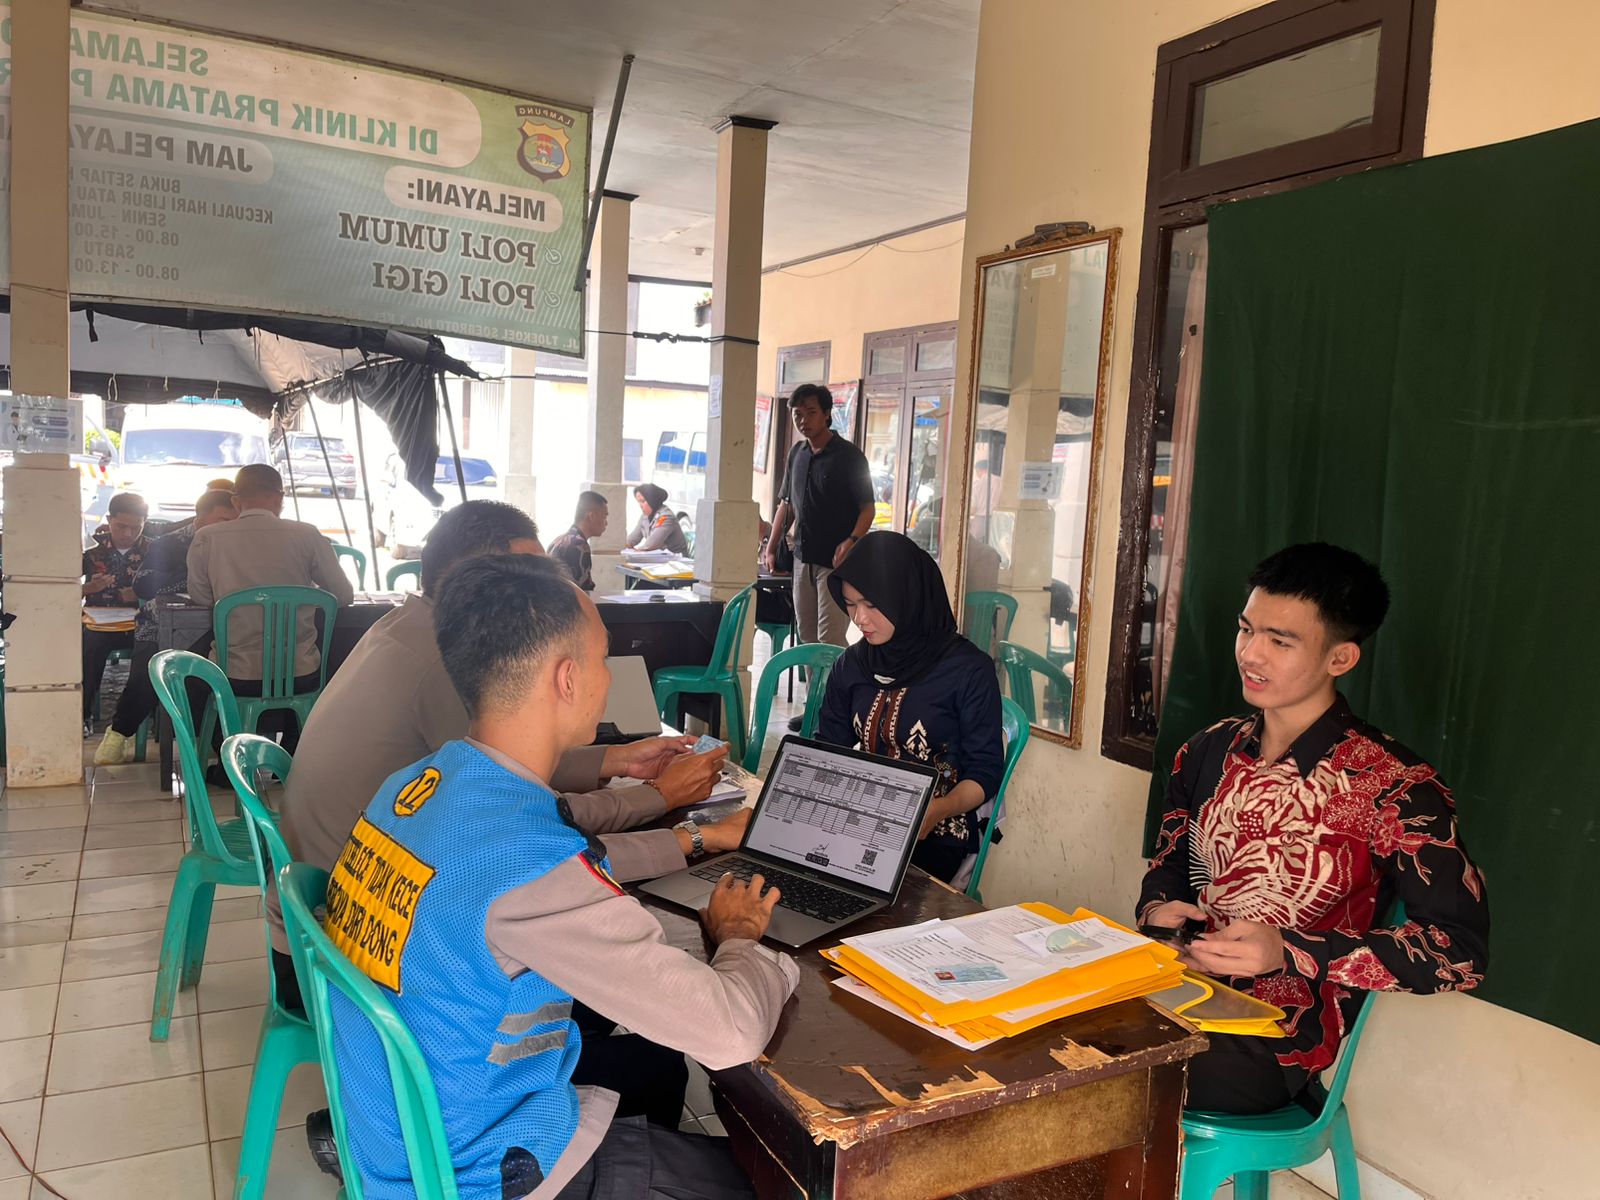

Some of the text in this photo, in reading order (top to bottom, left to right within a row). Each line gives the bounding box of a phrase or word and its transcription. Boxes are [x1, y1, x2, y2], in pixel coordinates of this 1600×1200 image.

[397, 772, 436, 811] 12
[364, 856, 395, 902] TIDAK
[385, 872, 420, 919] KECE
[360, 914, 397, 967] DONG
